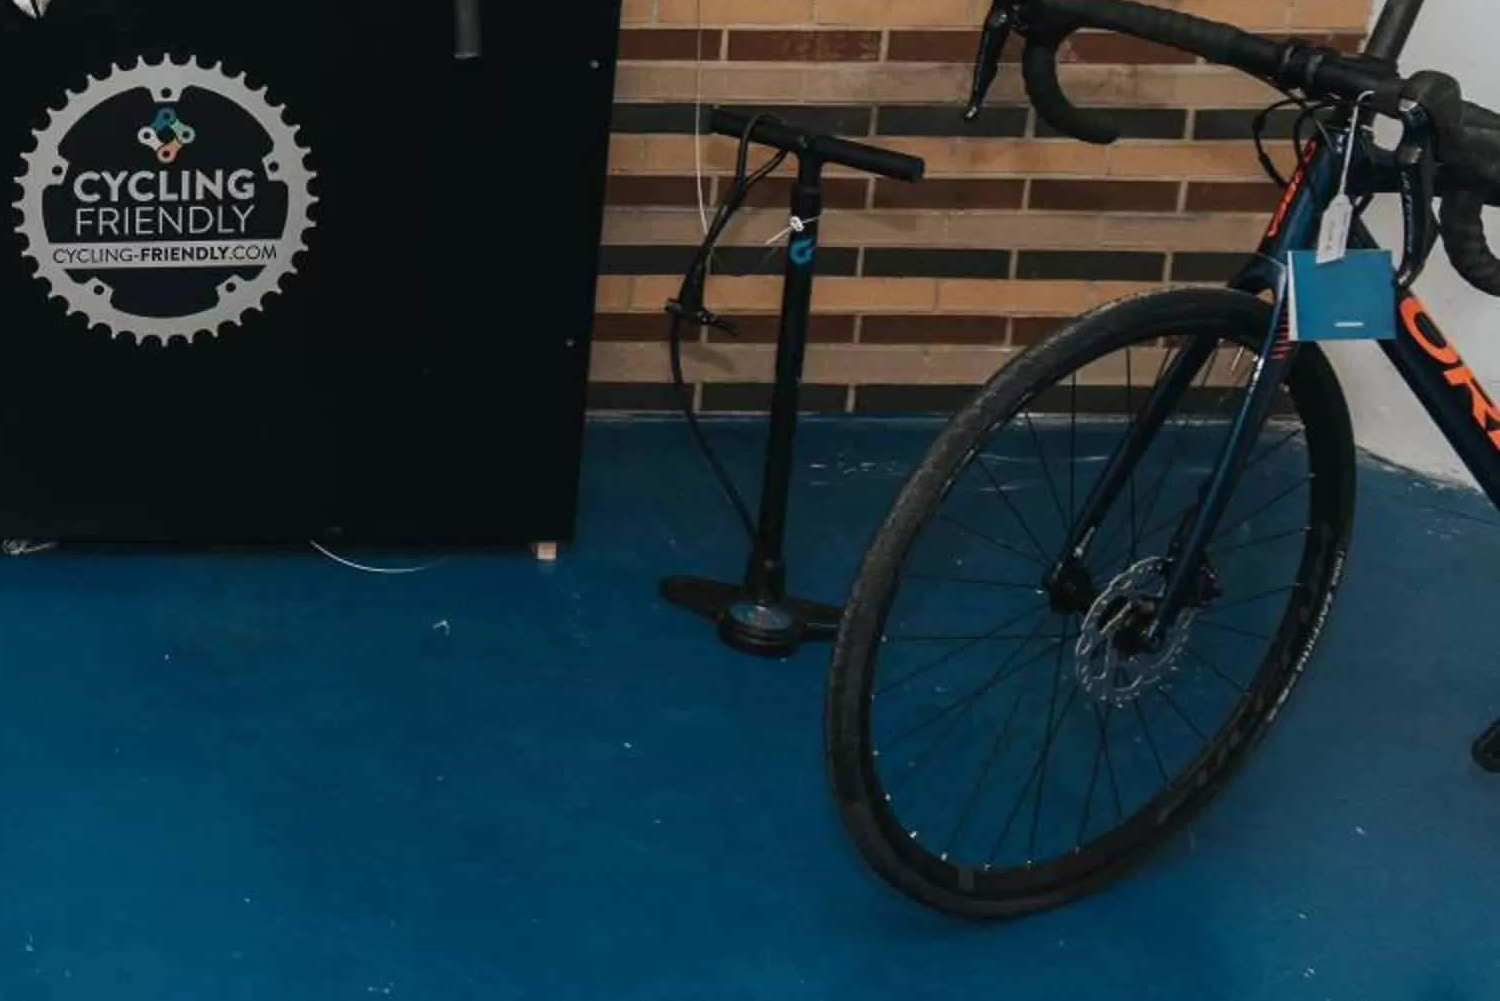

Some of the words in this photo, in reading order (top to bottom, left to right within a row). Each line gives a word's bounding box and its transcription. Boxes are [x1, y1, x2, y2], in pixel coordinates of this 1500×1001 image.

[73, 168, 256, 202] CYCLING
[75, 204, 255, 237] FRIENDLY
[53, 245, 277, 264] CYCLING-FRIENDLY.COM
[1401, 296, 1500, 451] OR
